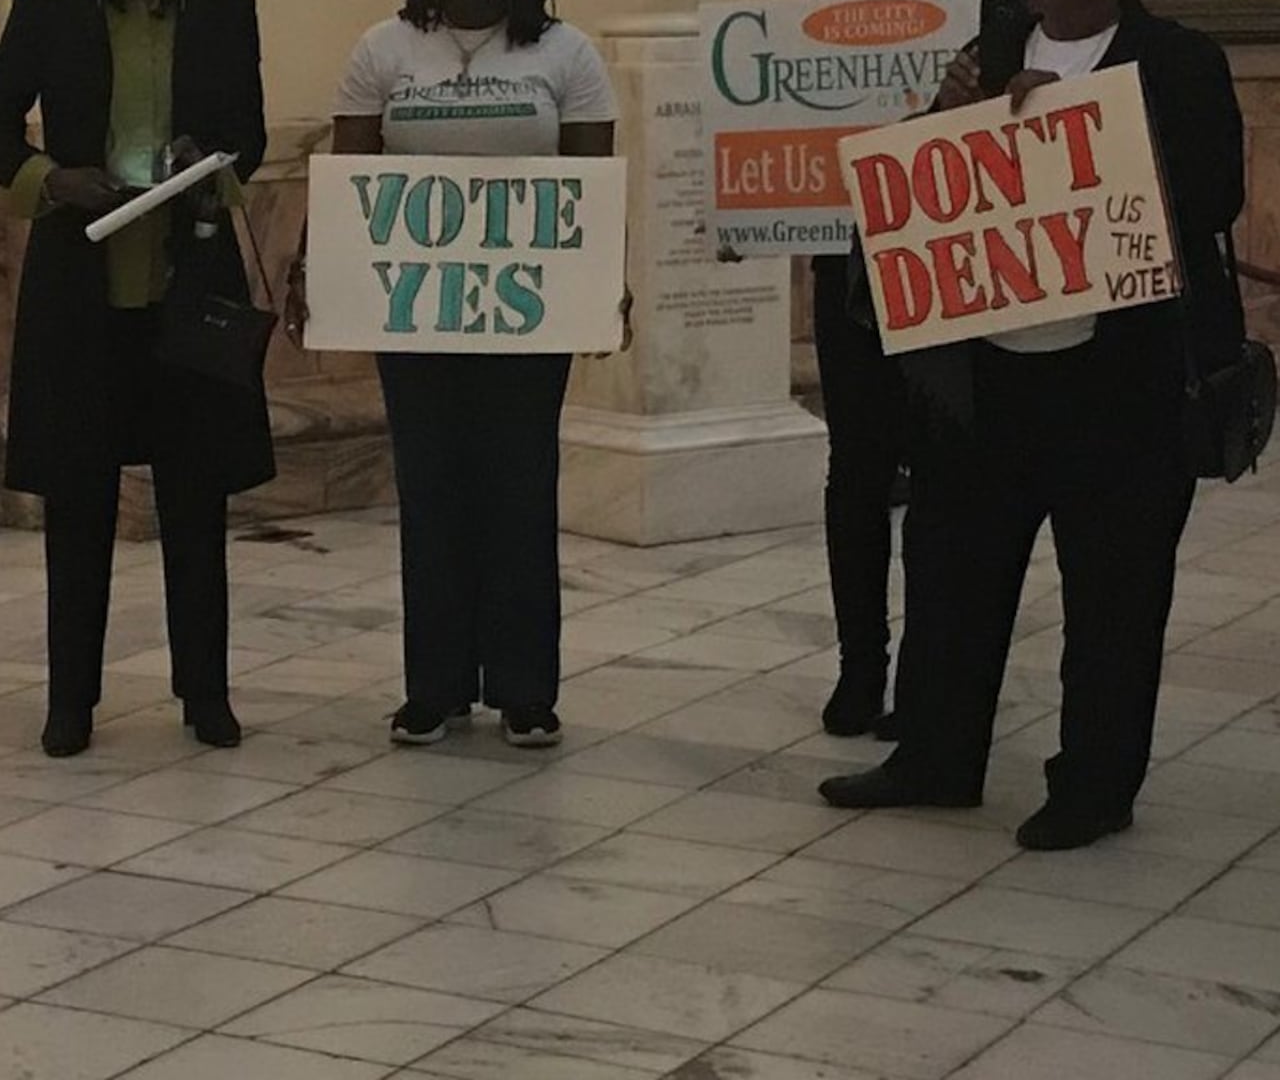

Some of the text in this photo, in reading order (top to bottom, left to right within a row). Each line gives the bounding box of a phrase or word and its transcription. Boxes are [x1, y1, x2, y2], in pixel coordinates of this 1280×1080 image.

[824, 24, 841, 38] IS
[832, 5, 916, 23] THE CITY
[712, 11, 960, 110] GREENHAVE
[721, 145, 825, 194] Let Us
[851, 101, 1102, 237] DON'T
[350, 173, 583, 250] VOTE
[1106, 194, 1146, 225] US
[873, 207, 1095, 331] DENY
[1112, 231, 1158, 263] THE
[372, 261, 544, 336] YES
